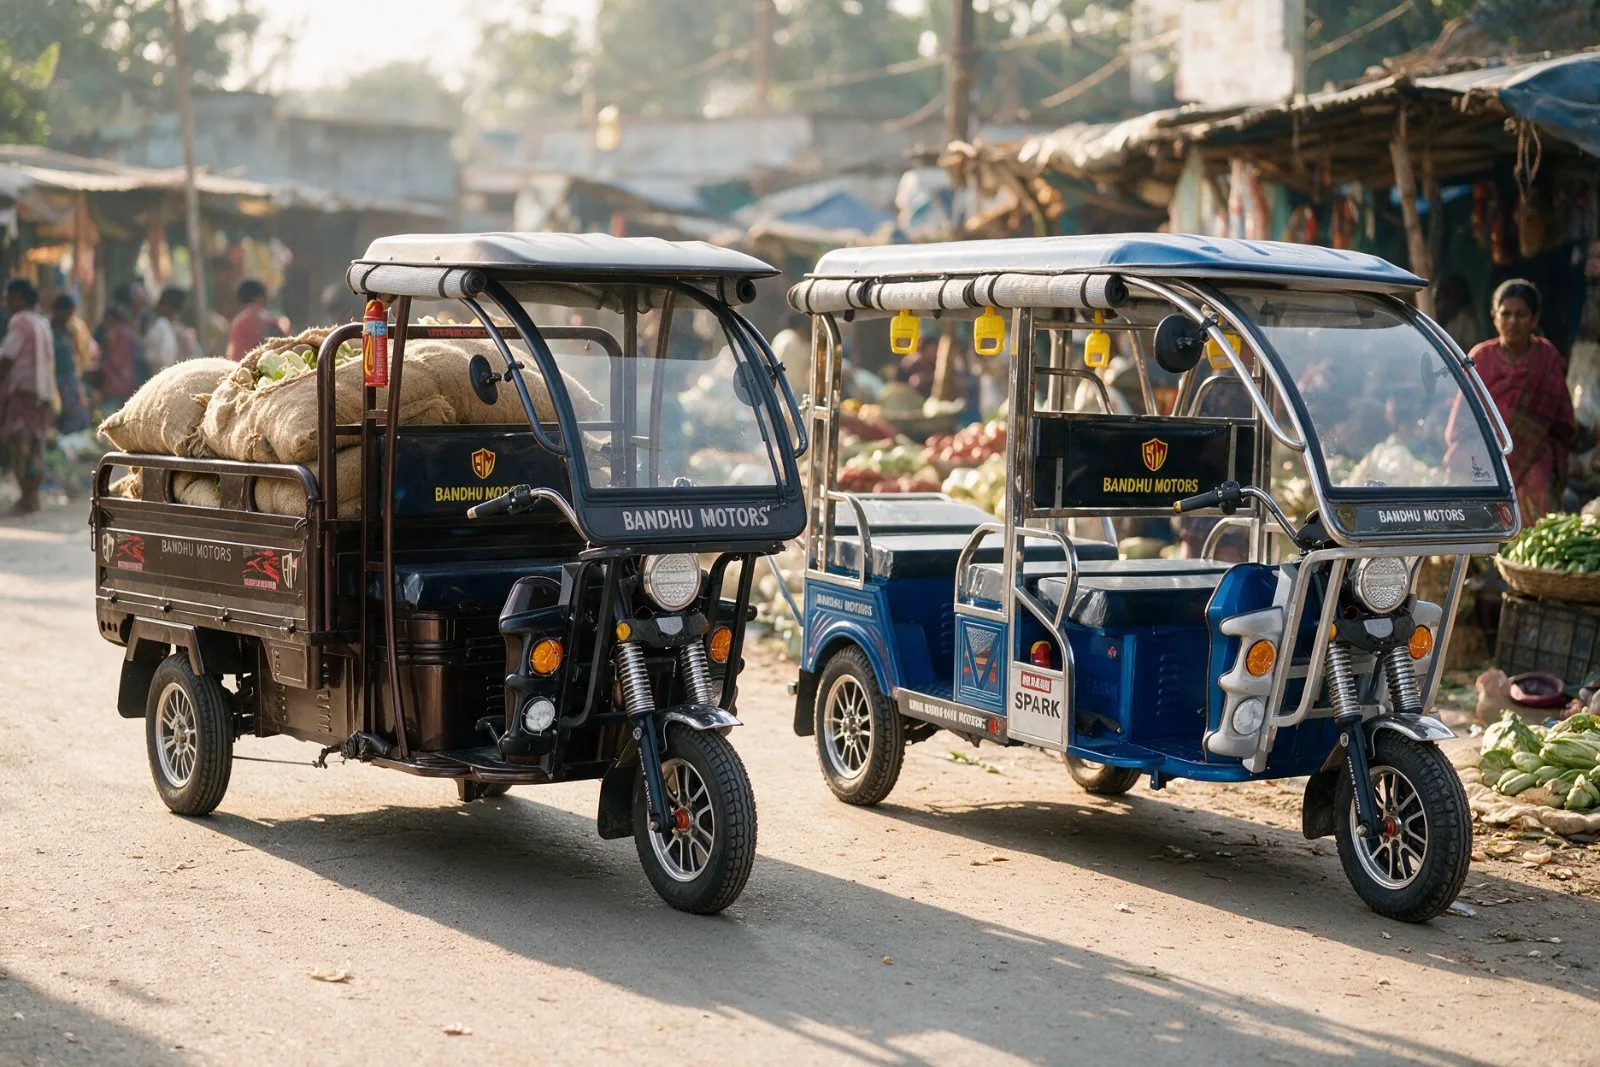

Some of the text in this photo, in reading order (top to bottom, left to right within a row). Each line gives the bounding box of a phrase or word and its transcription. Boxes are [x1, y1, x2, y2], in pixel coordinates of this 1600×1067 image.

[435, 486, 483, 501] BANDHU
[1103, 477, 1199, 493] BANDHU MOTORS
[622, 509, 694, 531] BANDHU
[1378, 509, 1466, 523] BANDHU MOTORS
[161, 539, 194, 557] BANDHU
[197, 543, 232, 562] MOTORS
[1015, 691, 1060, 719] SPARK
